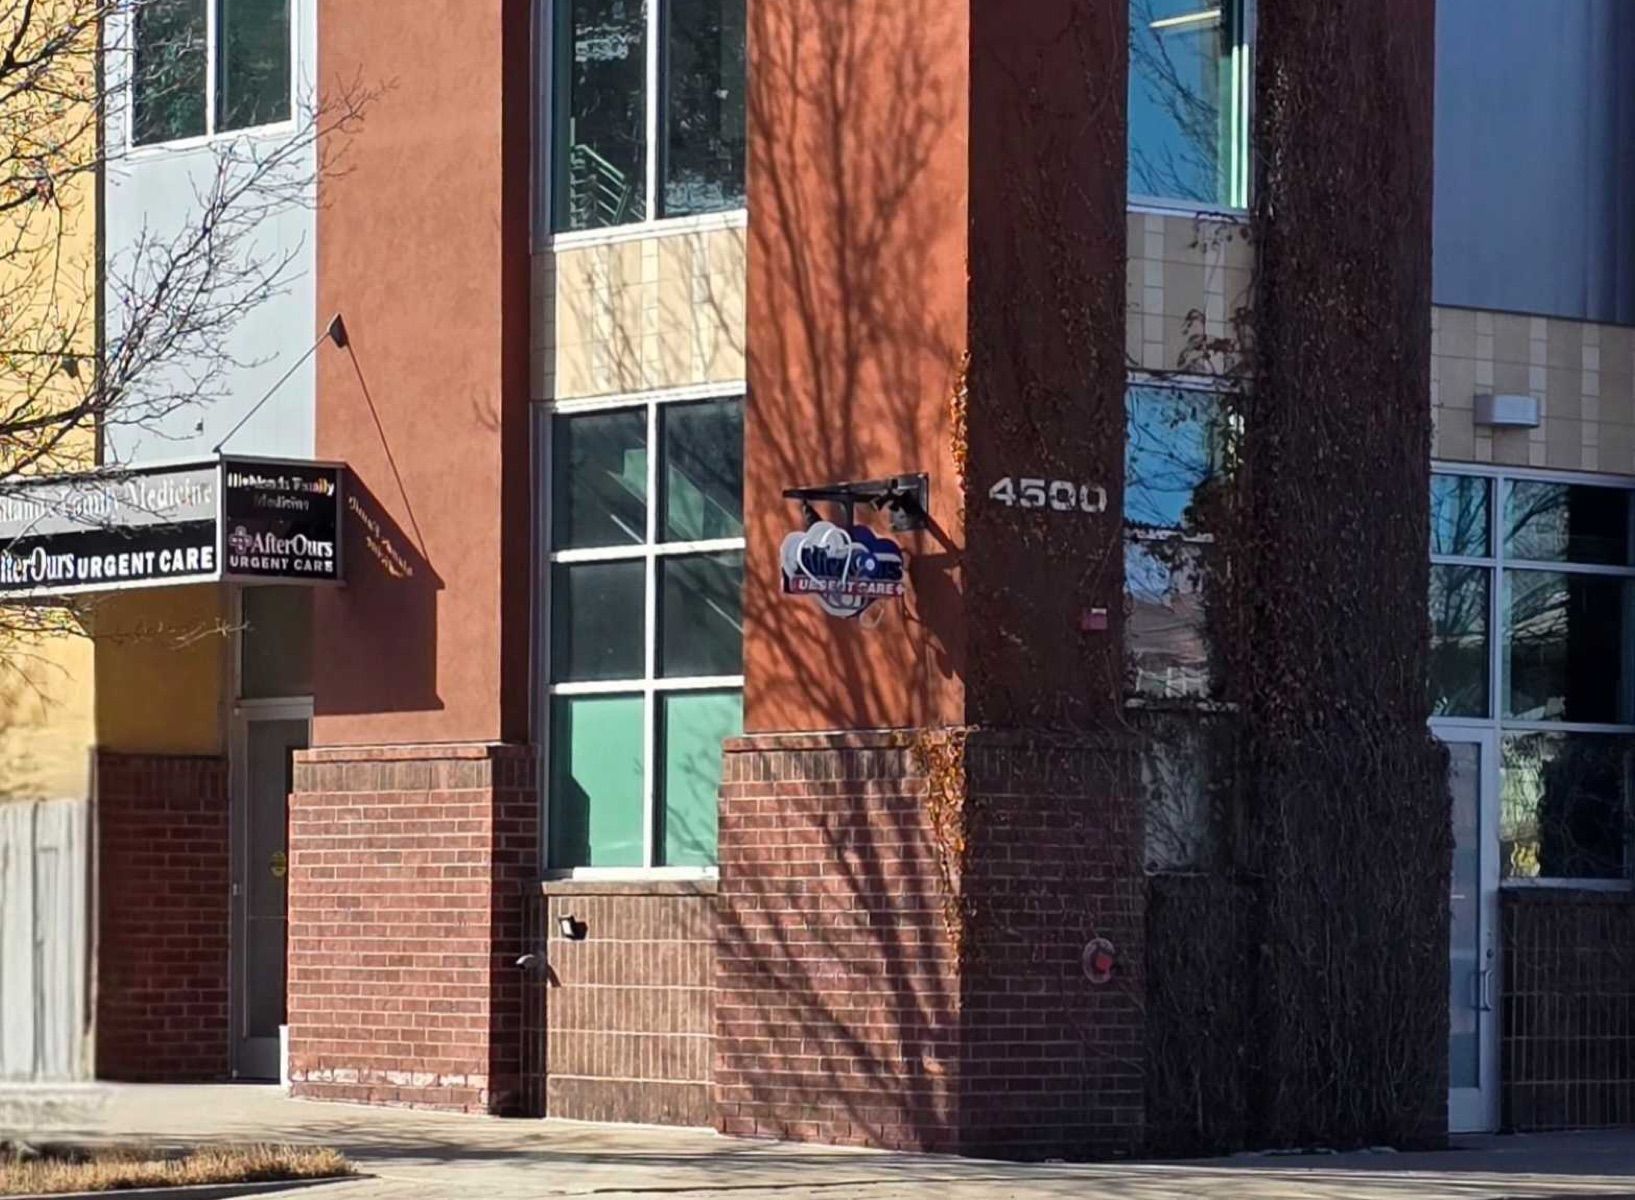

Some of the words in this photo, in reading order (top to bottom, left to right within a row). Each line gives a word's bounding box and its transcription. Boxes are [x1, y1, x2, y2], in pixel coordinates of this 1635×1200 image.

[988, 476, 1108, 513] 4500
[77, 552, 155, 580] URGENT
[159, 545, 214, 572] CARE
[229, 555, 289, 570] URGENT
[293, 559, 334, 573] CARE
